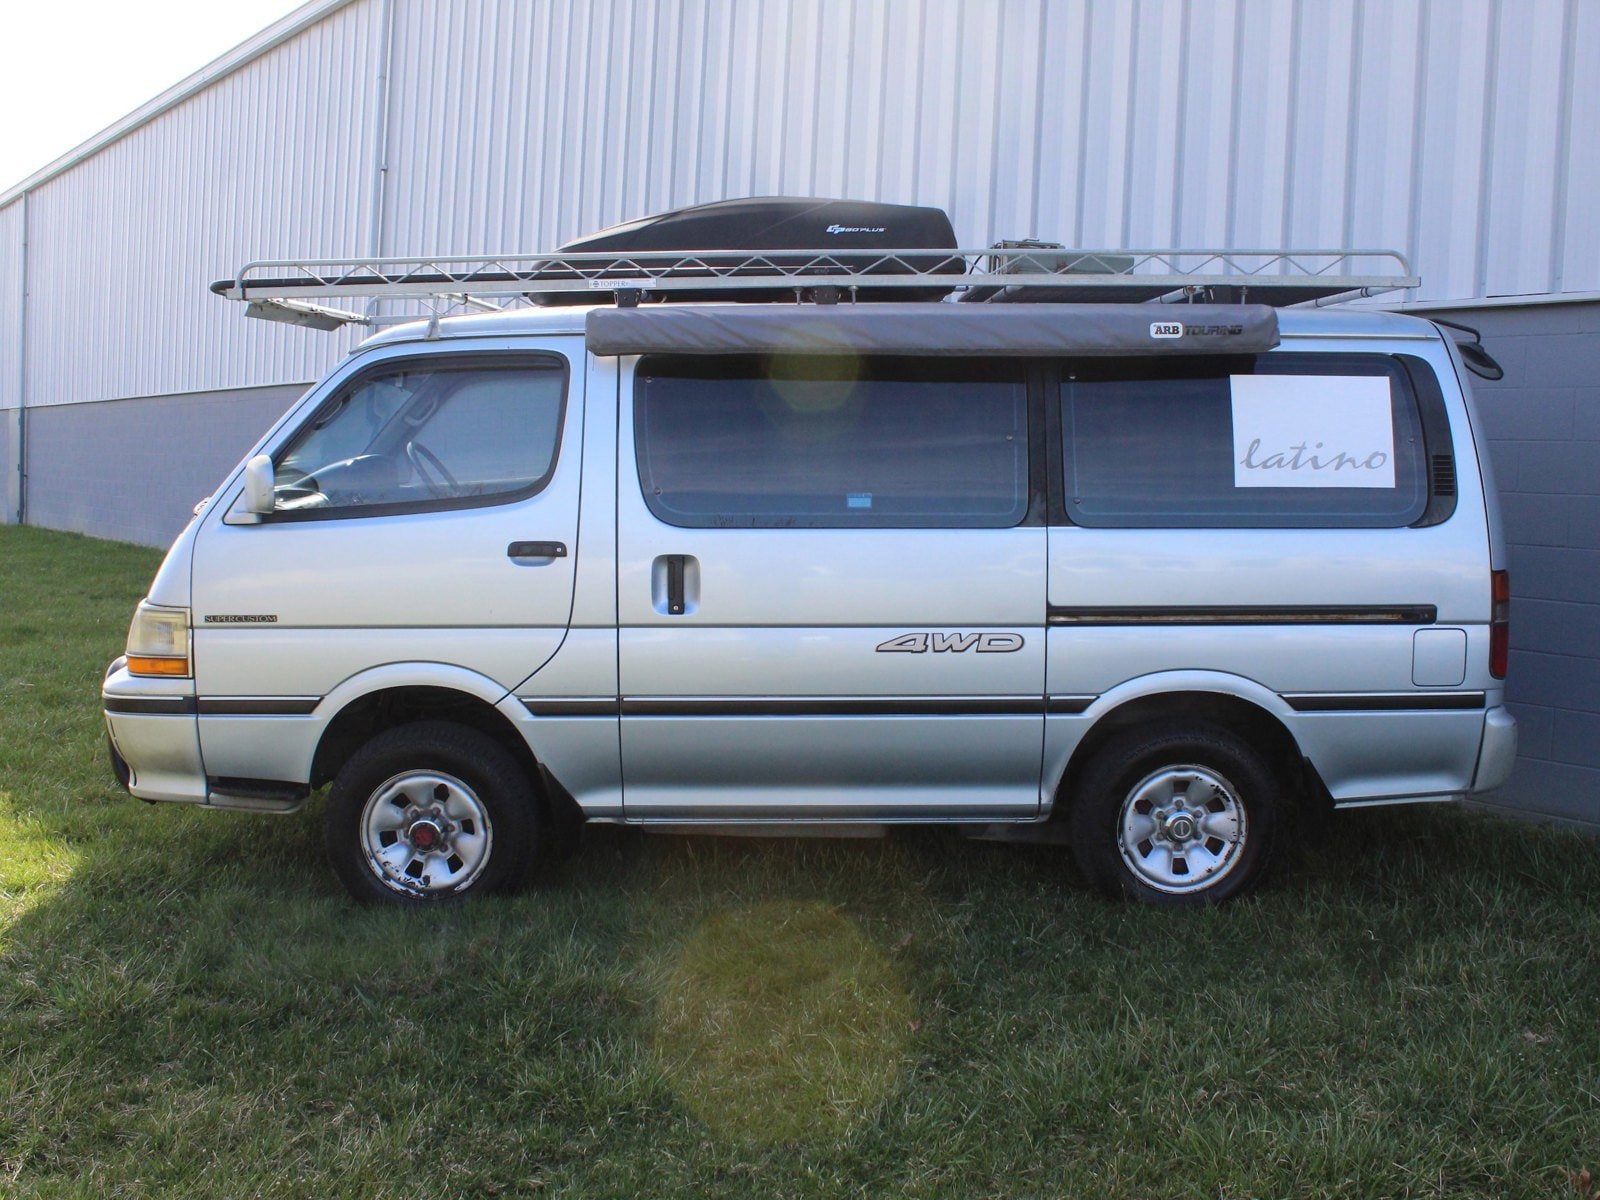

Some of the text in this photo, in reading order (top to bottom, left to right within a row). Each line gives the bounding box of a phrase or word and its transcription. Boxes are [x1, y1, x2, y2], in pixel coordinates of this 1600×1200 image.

[1154, 325, 1243, 336] ARB TOURING
[1240, 438, 1388, 471] latino
[875, 632, 1025, 653] 4WD
